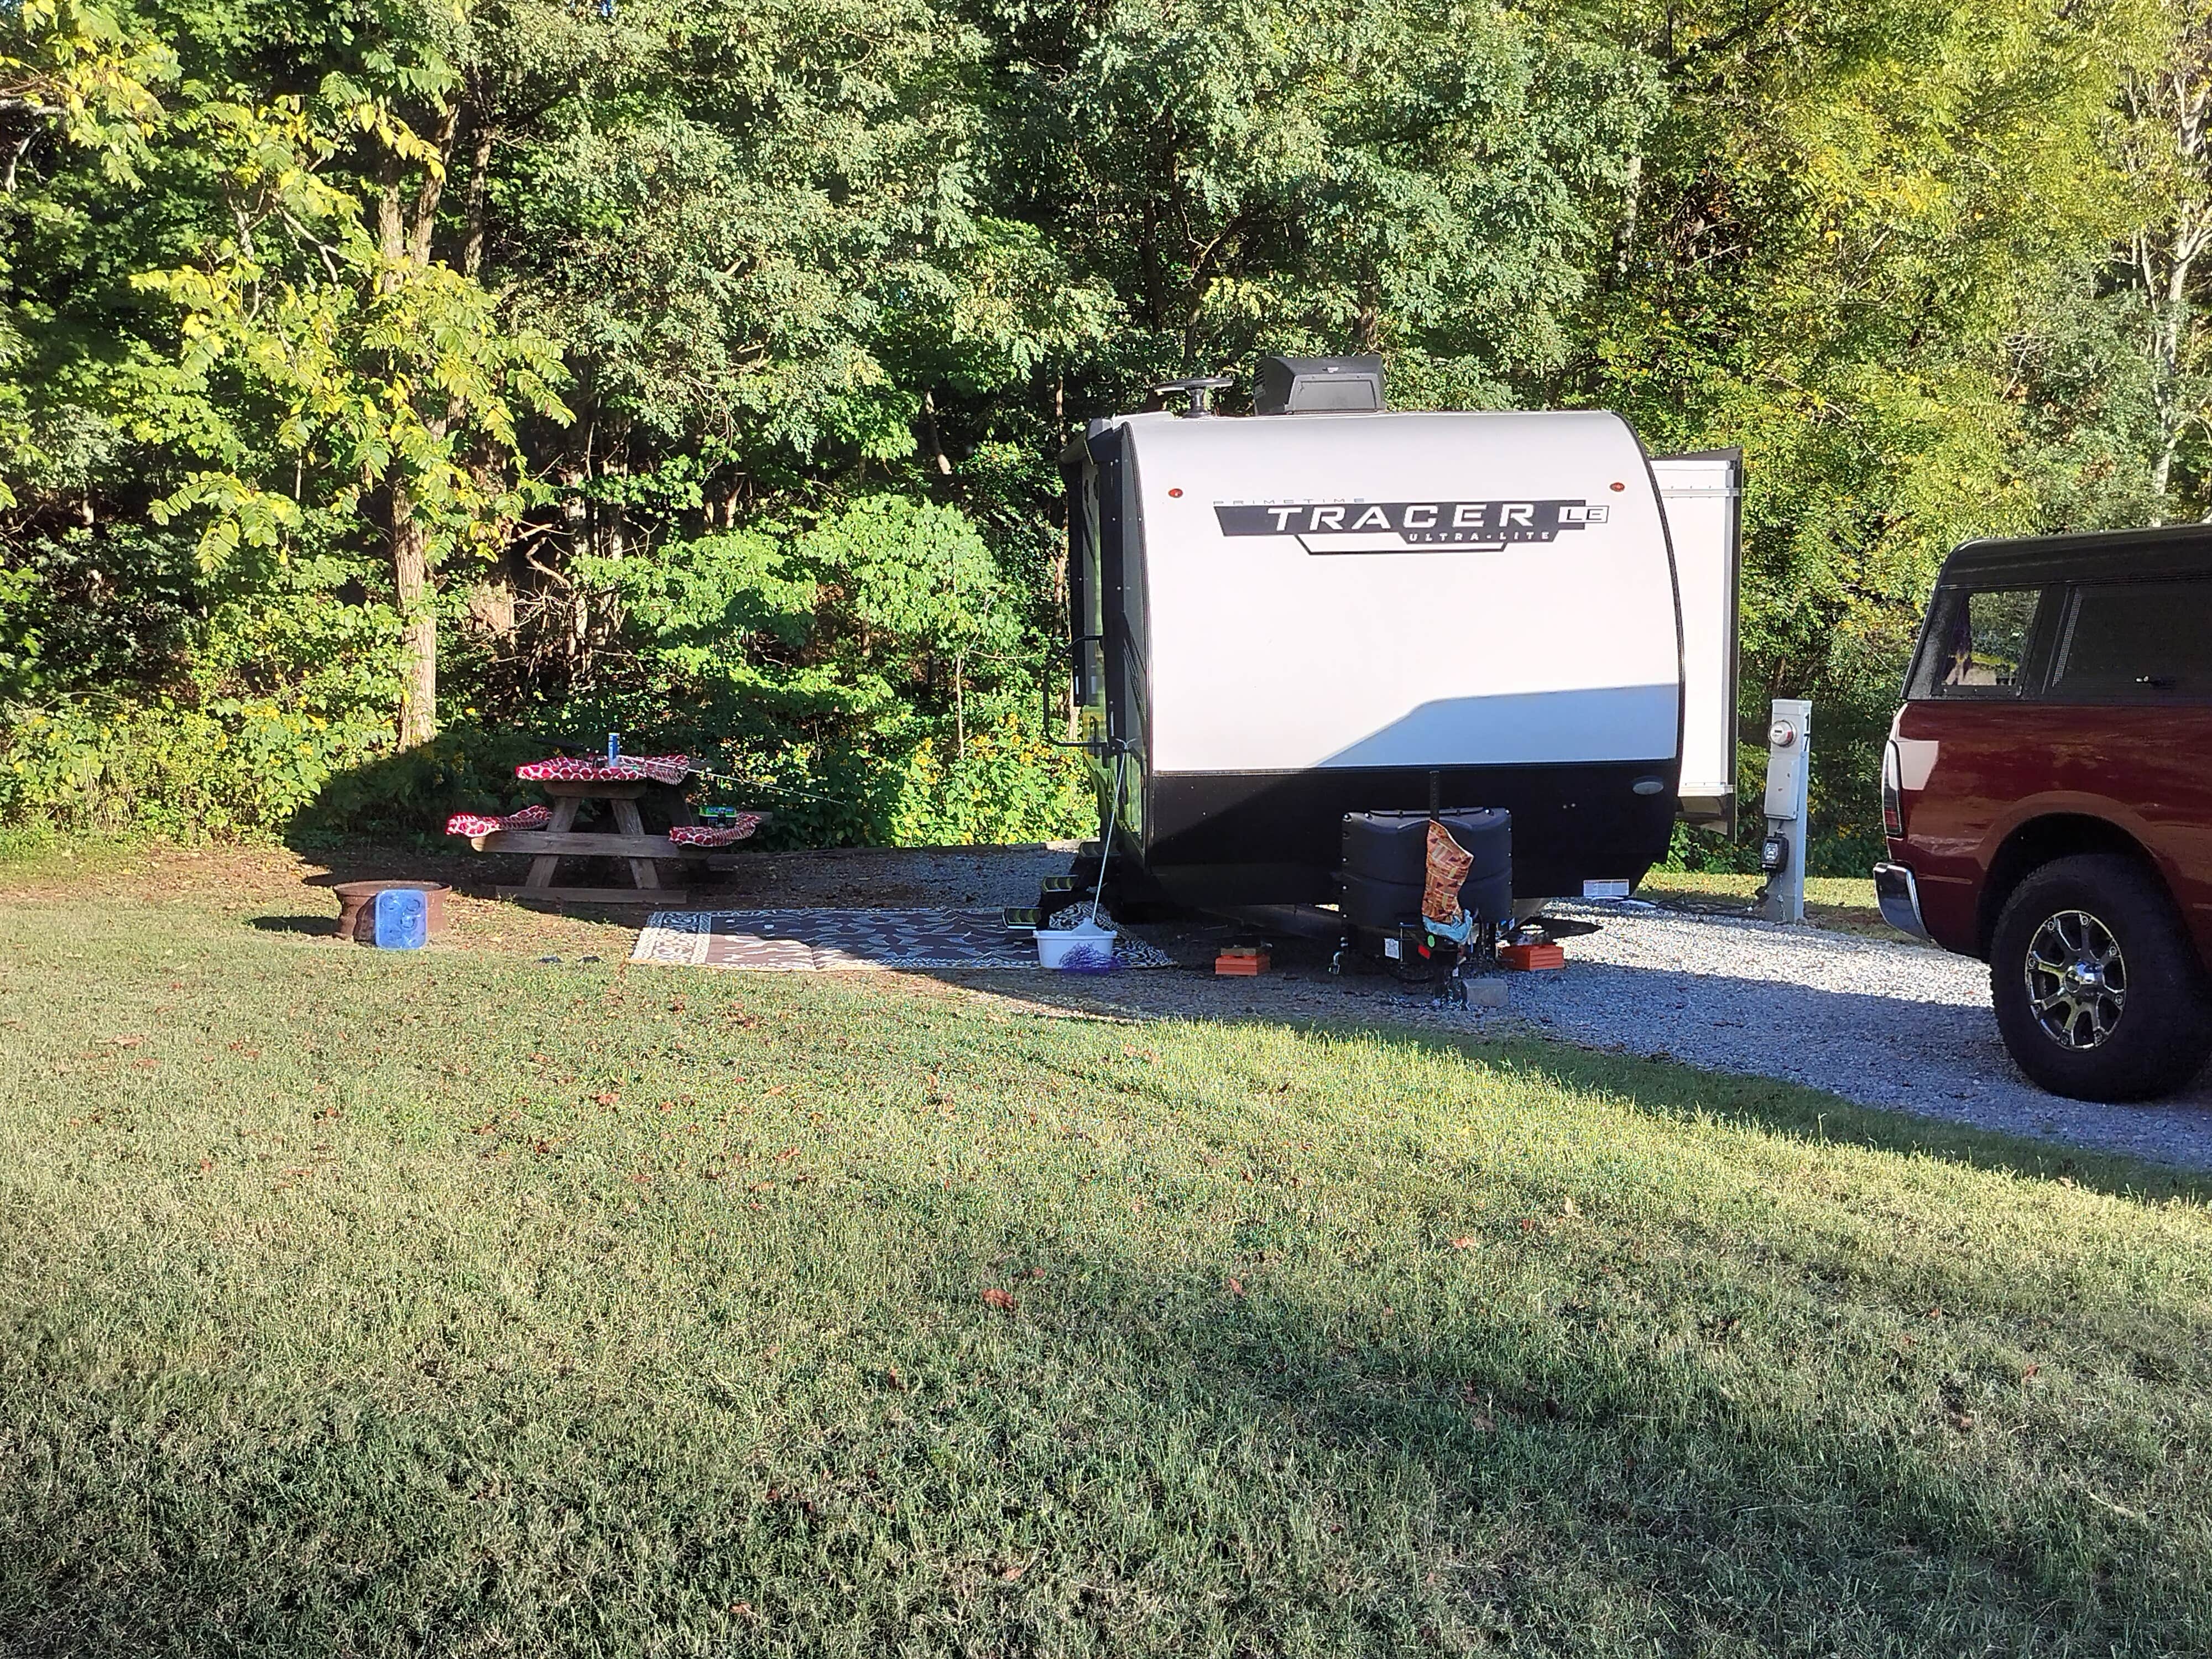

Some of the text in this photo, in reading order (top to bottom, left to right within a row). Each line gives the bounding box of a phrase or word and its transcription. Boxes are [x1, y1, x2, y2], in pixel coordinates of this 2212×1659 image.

[1267, 503, 1534, 531] TRACER
[1565, 508, 1605, 521] LE
[1408, 532, 1549, 542] ULTRA-LITE
[1803, 713, 1810, 752] 17
